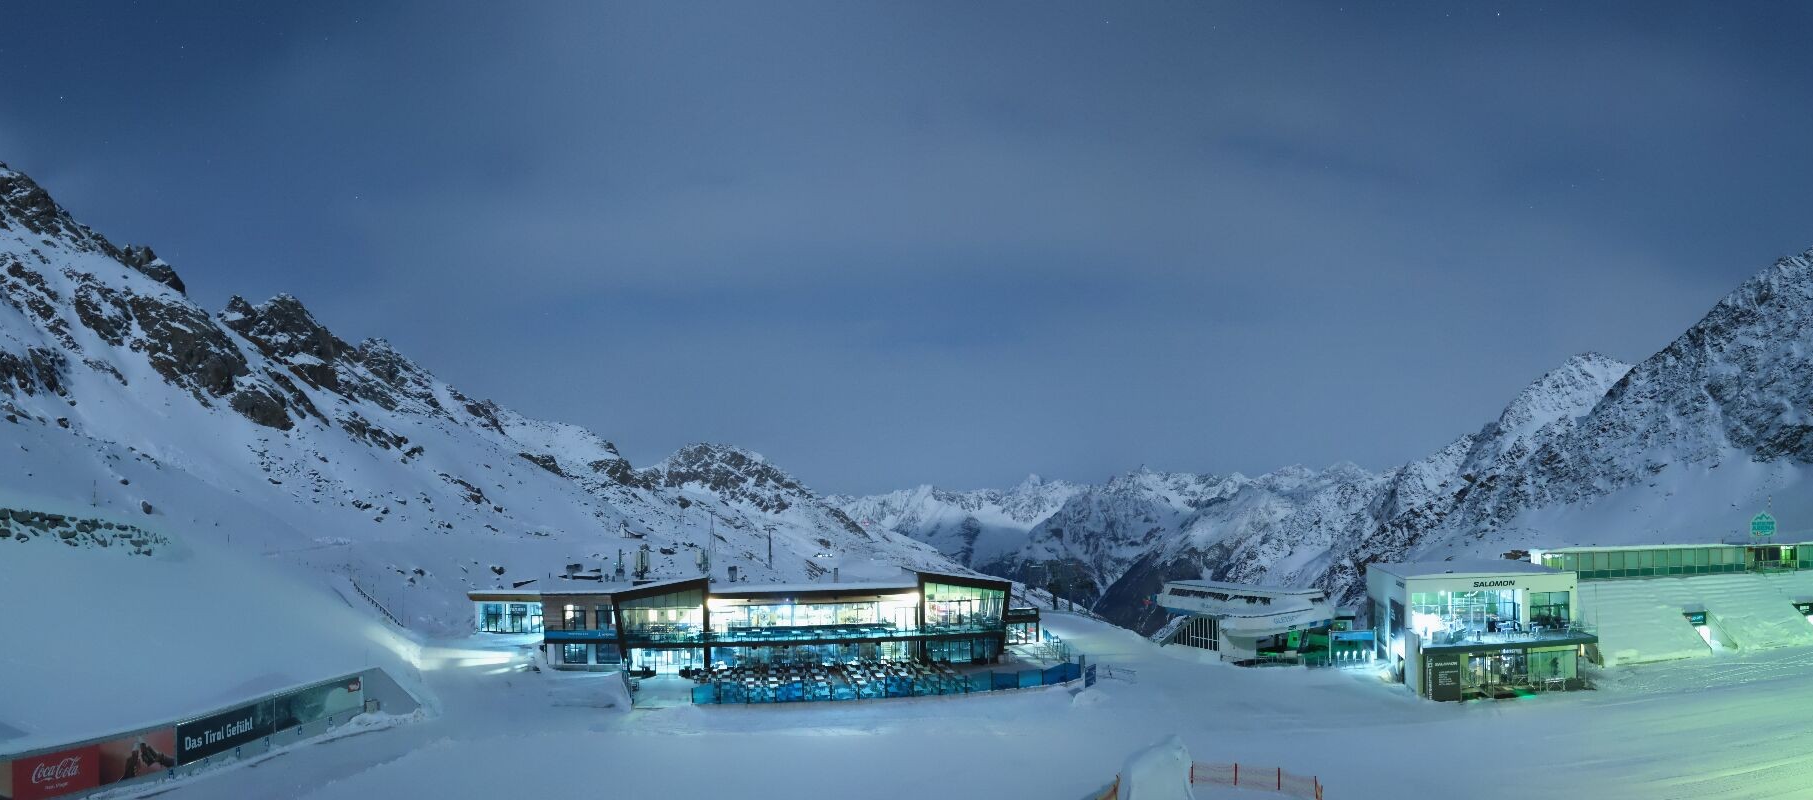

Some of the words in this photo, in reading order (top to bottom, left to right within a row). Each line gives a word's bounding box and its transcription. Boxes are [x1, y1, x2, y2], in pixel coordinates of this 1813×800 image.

[1473, 580, 1516, 588] SALOMON
[184, 736, 203, 751] Das
[204, 726, 225, 745] Tirol
[226, 716, 254, 738] Gefühl
